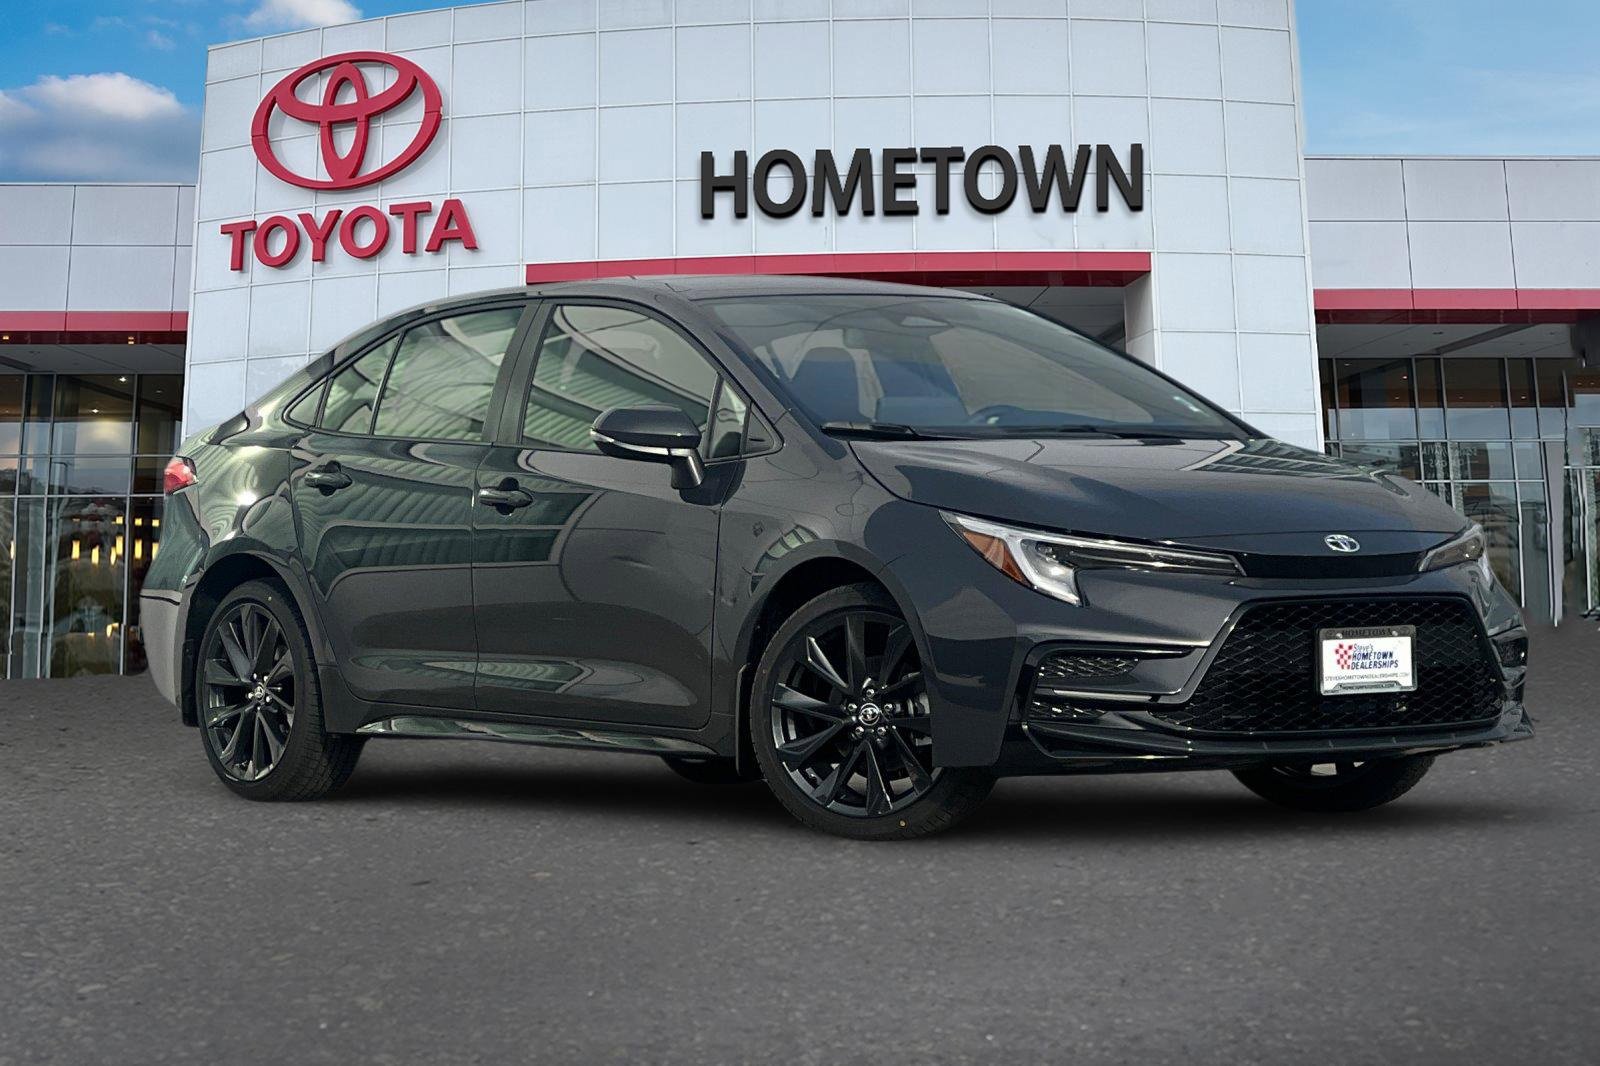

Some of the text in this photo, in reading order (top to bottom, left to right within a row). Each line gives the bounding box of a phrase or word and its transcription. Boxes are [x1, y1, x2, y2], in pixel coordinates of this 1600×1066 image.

[700, 143, 1145, 219] HOMETOWN
[220, 198, 479, 272] TOYOTA
[1353, 643, 1374, 652] Steve's
[1352, 651, 1394, 660] HOMETOWN
[1351, 659, 1399, 670] DEALERSHIPS
